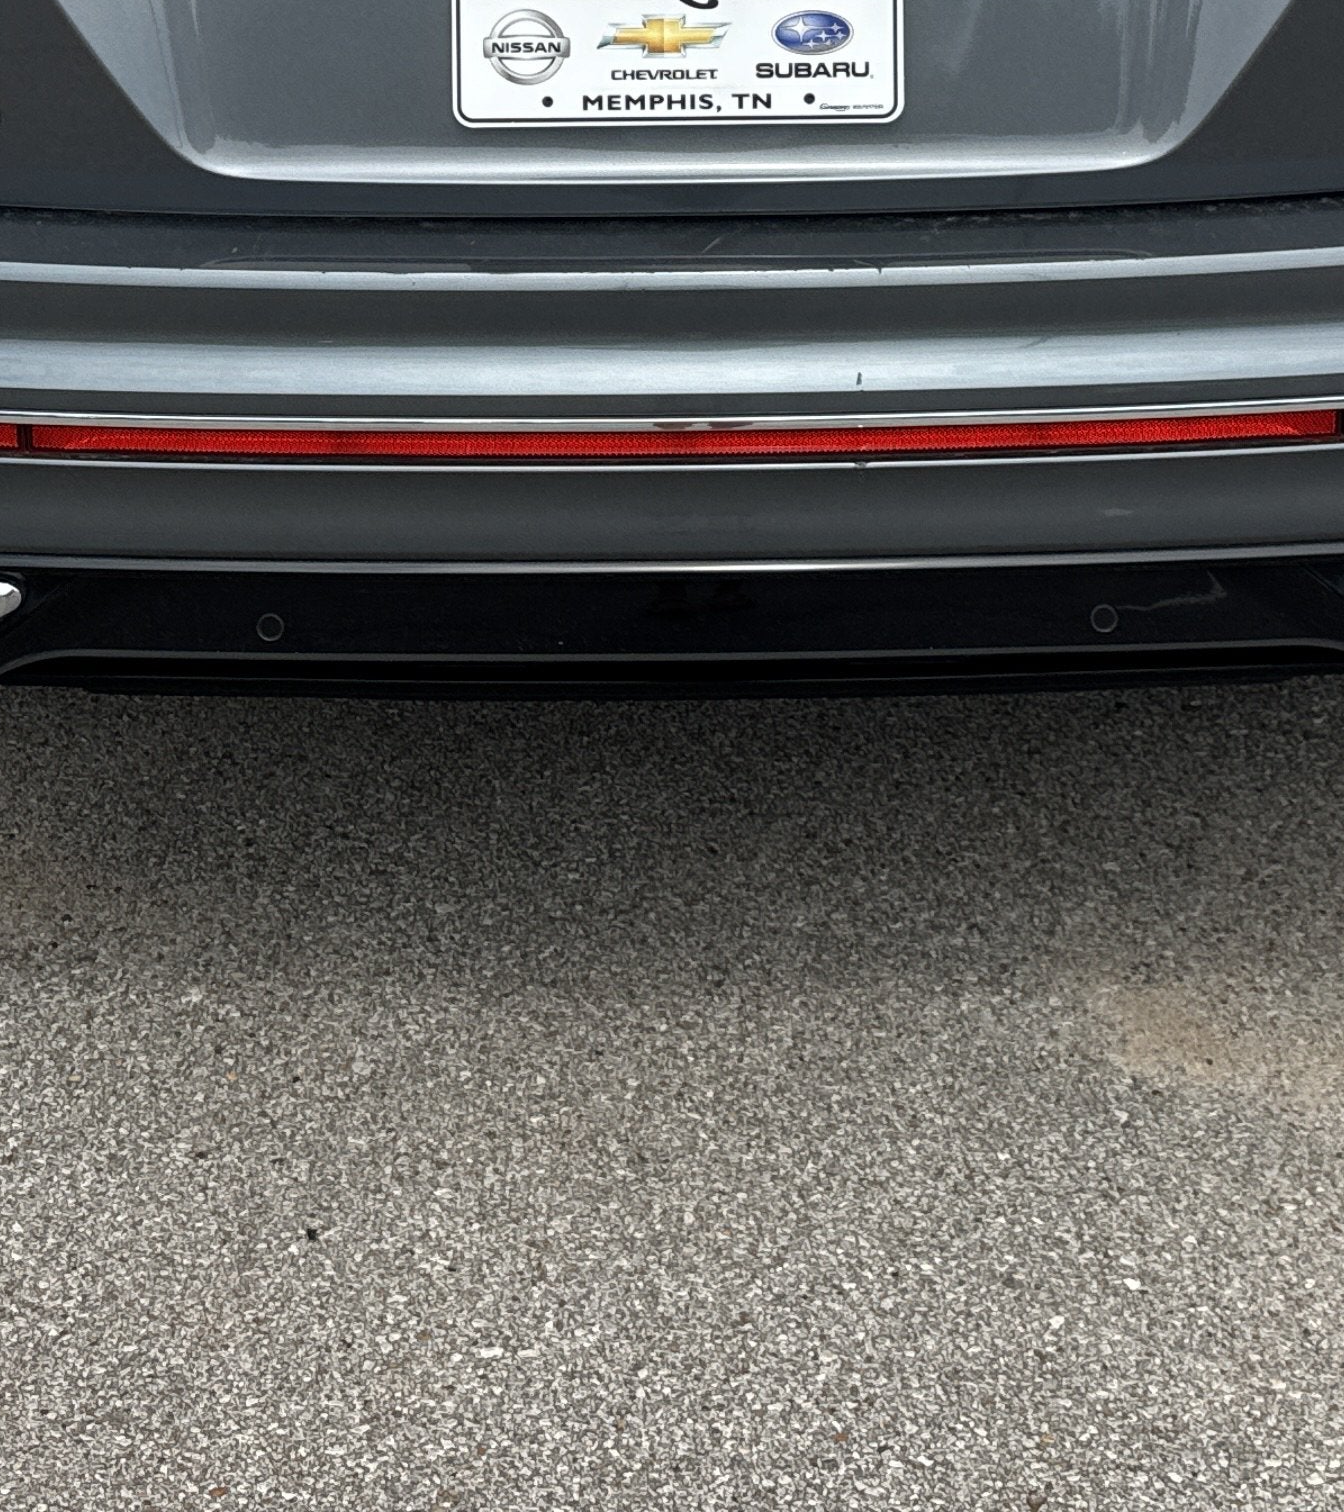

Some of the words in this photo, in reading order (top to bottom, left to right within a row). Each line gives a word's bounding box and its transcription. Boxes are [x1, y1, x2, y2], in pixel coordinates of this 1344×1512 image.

[491, 41, 562, 54] NISSAN
[610, 68, 719, 81] CHEVROLET
[755, 61, 870, 79] SUBARU
[582, 93, 722, 113] MEMPHIS,
[731, 92, 773, 110] TN
